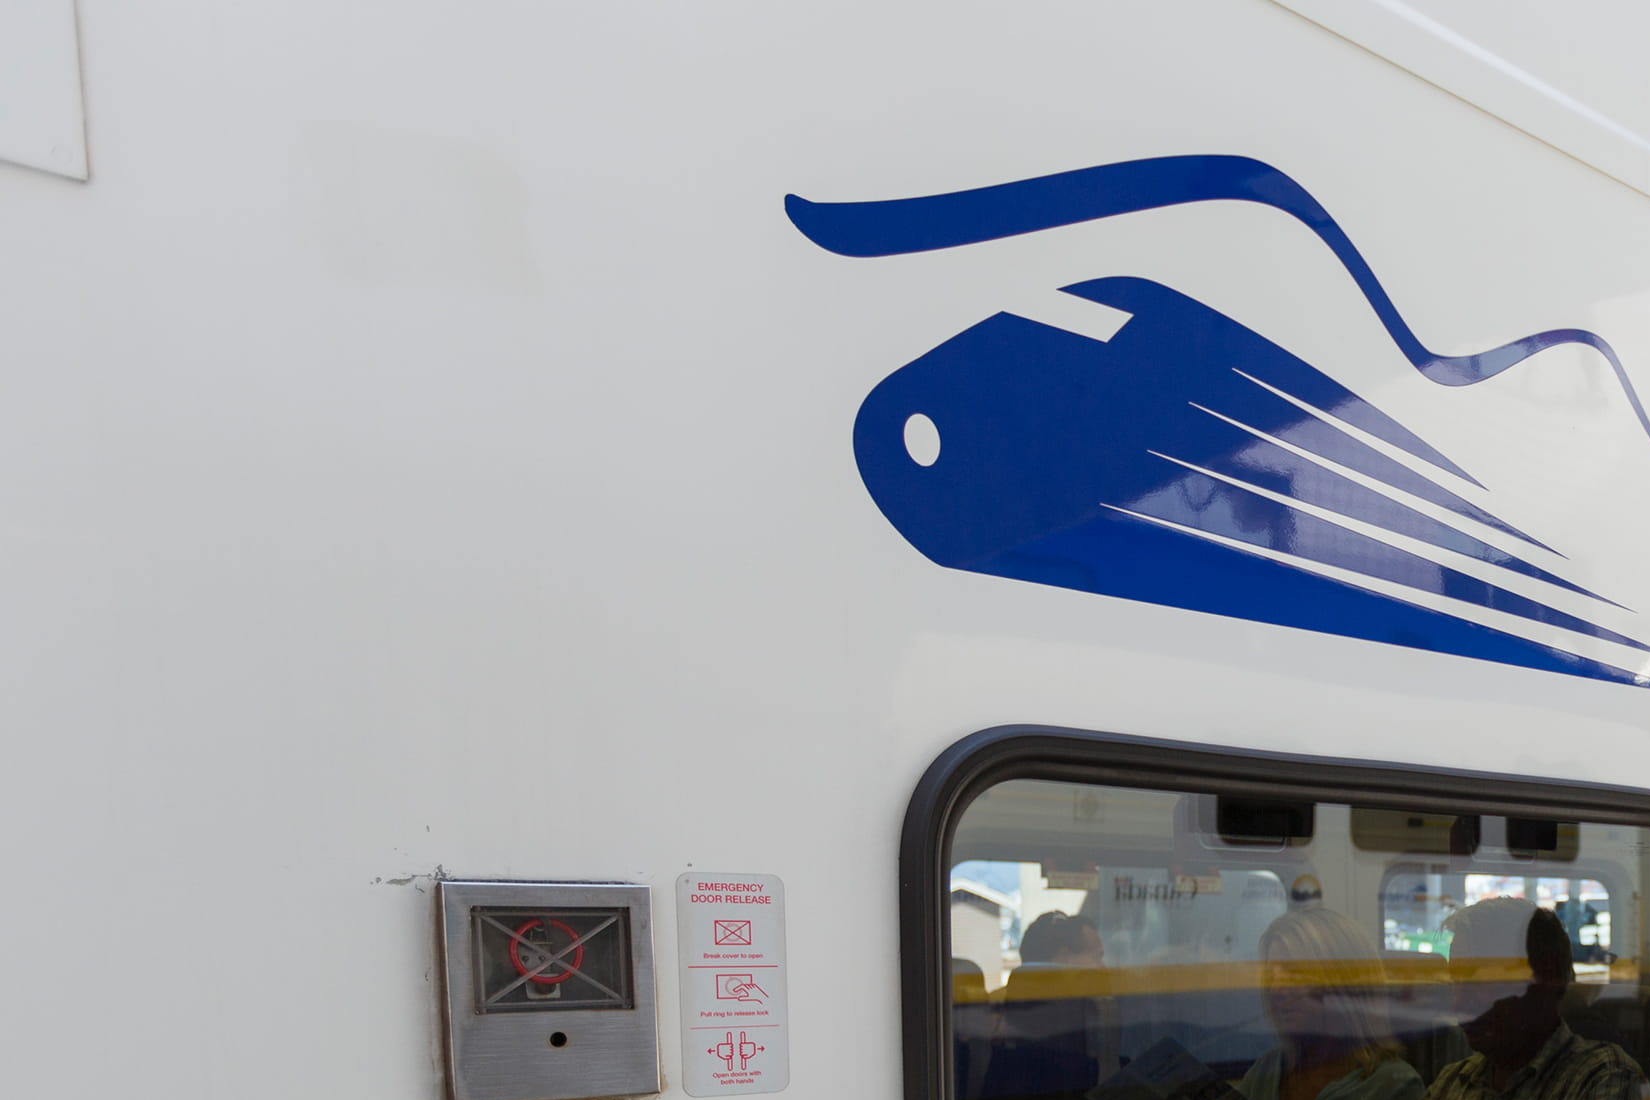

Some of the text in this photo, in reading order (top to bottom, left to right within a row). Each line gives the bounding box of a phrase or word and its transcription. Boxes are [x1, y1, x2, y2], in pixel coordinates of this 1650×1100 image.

[697, 882, 764, 893] EMERGENCY
[690, 894, 772, 905] DOOR RELEASE
